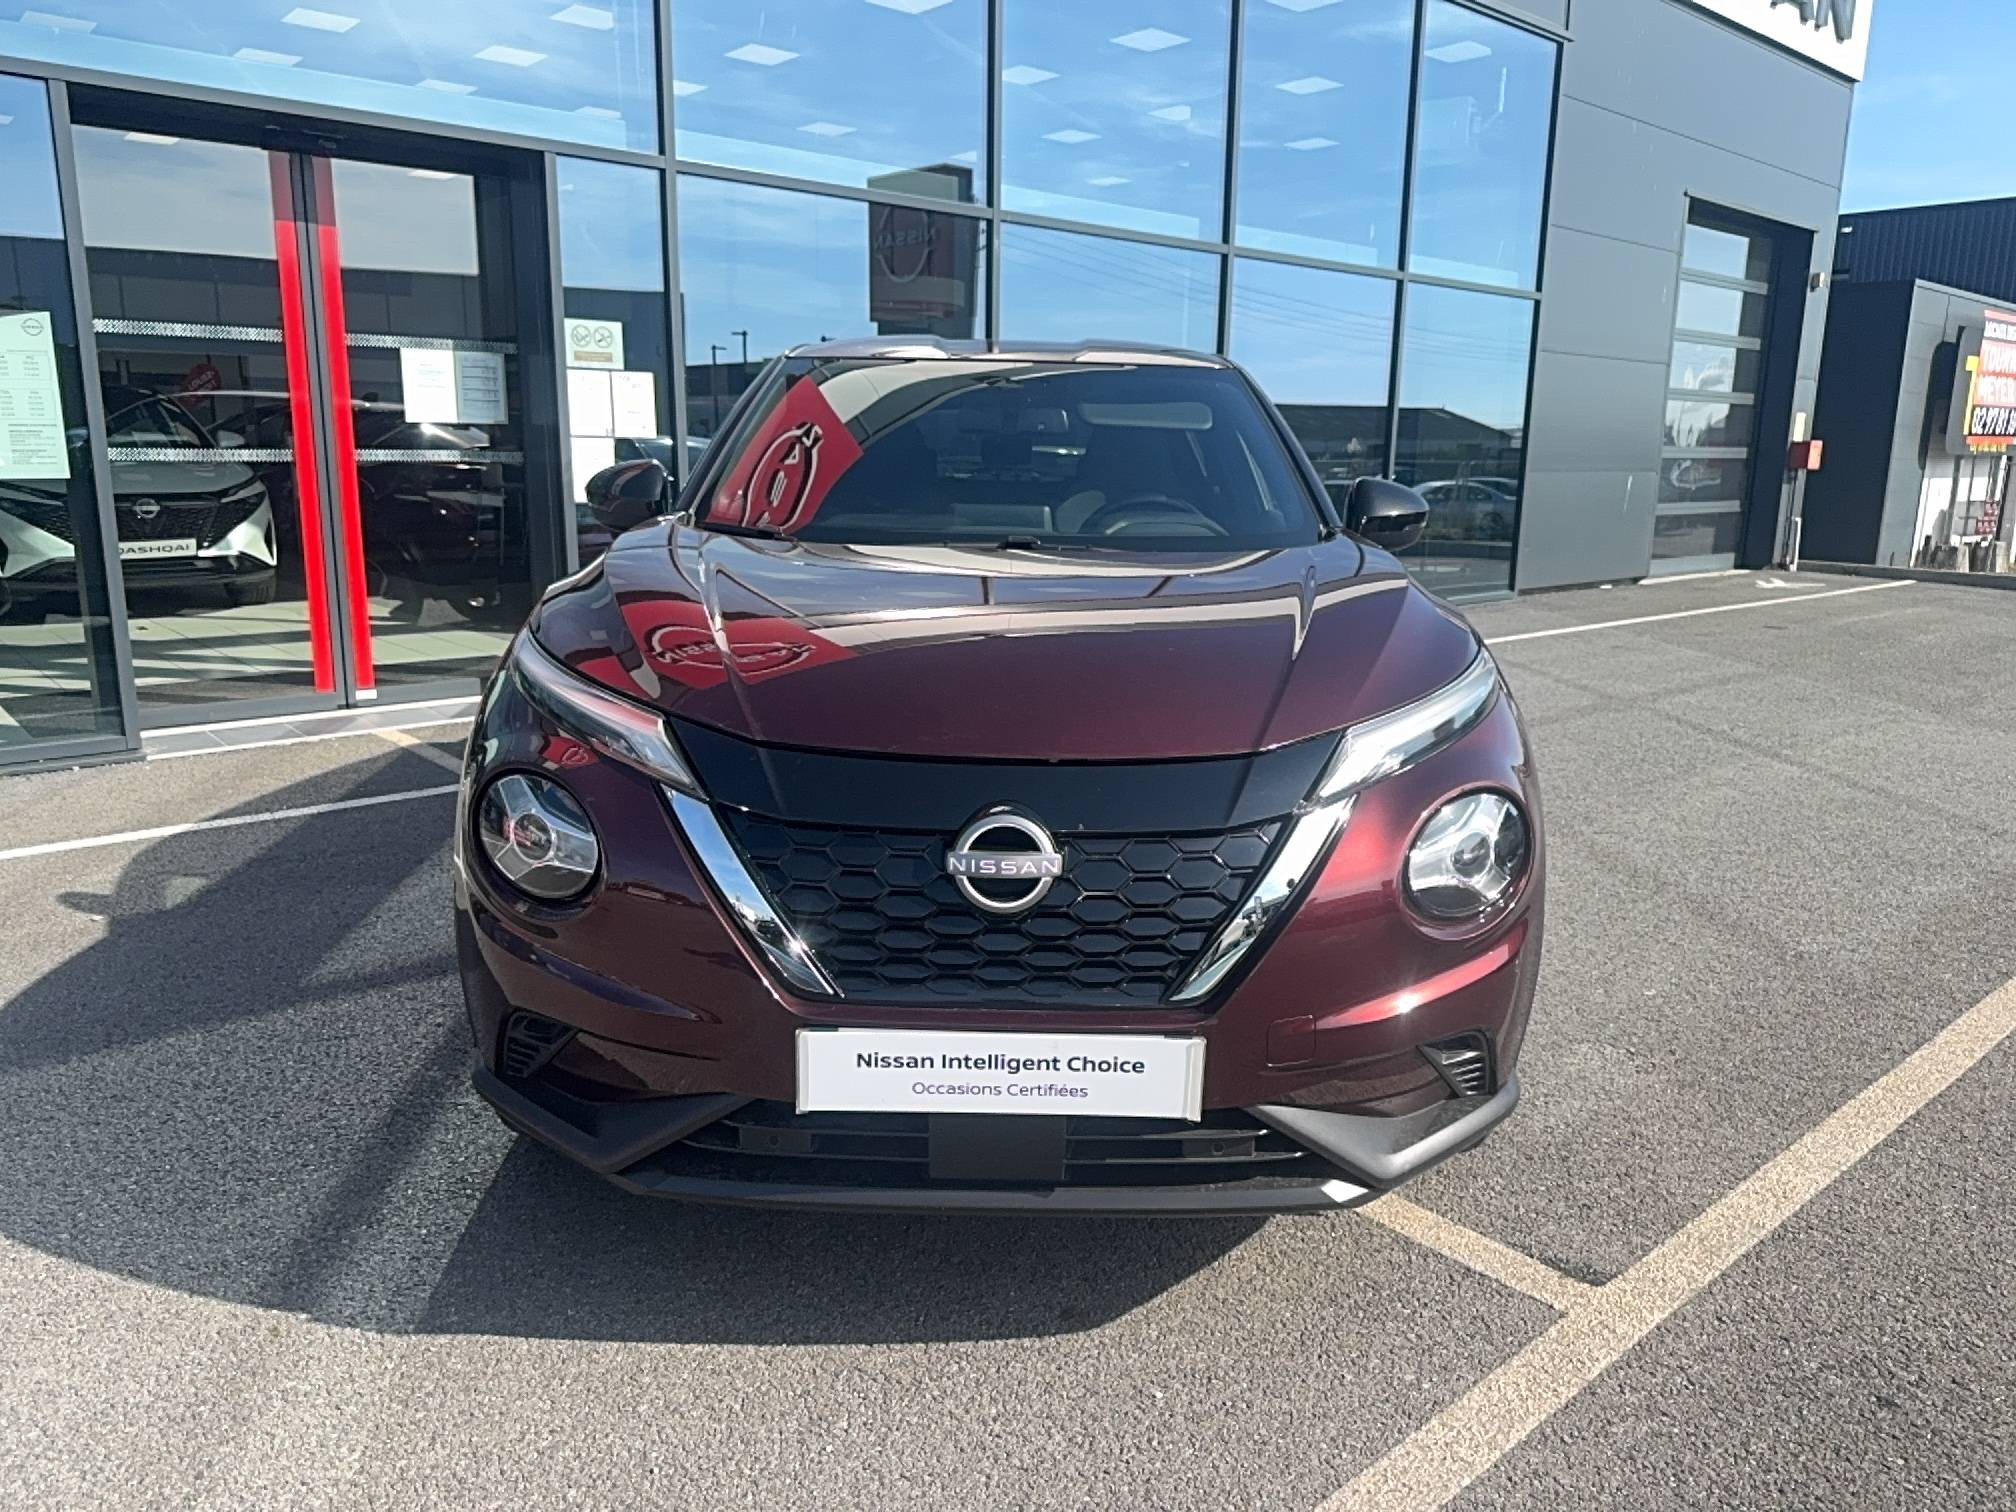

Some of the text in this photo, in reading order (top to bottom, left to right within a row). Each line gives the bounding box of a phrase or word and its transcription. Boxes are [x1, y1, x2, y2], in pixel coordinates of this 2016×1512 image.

[949, 856, 1059, 875] NISSAN
[856, 1052, 1145, 1074] Nissan Intelligent Choice
[911, 1081, 1089, 1098] Occasions Certifiées
